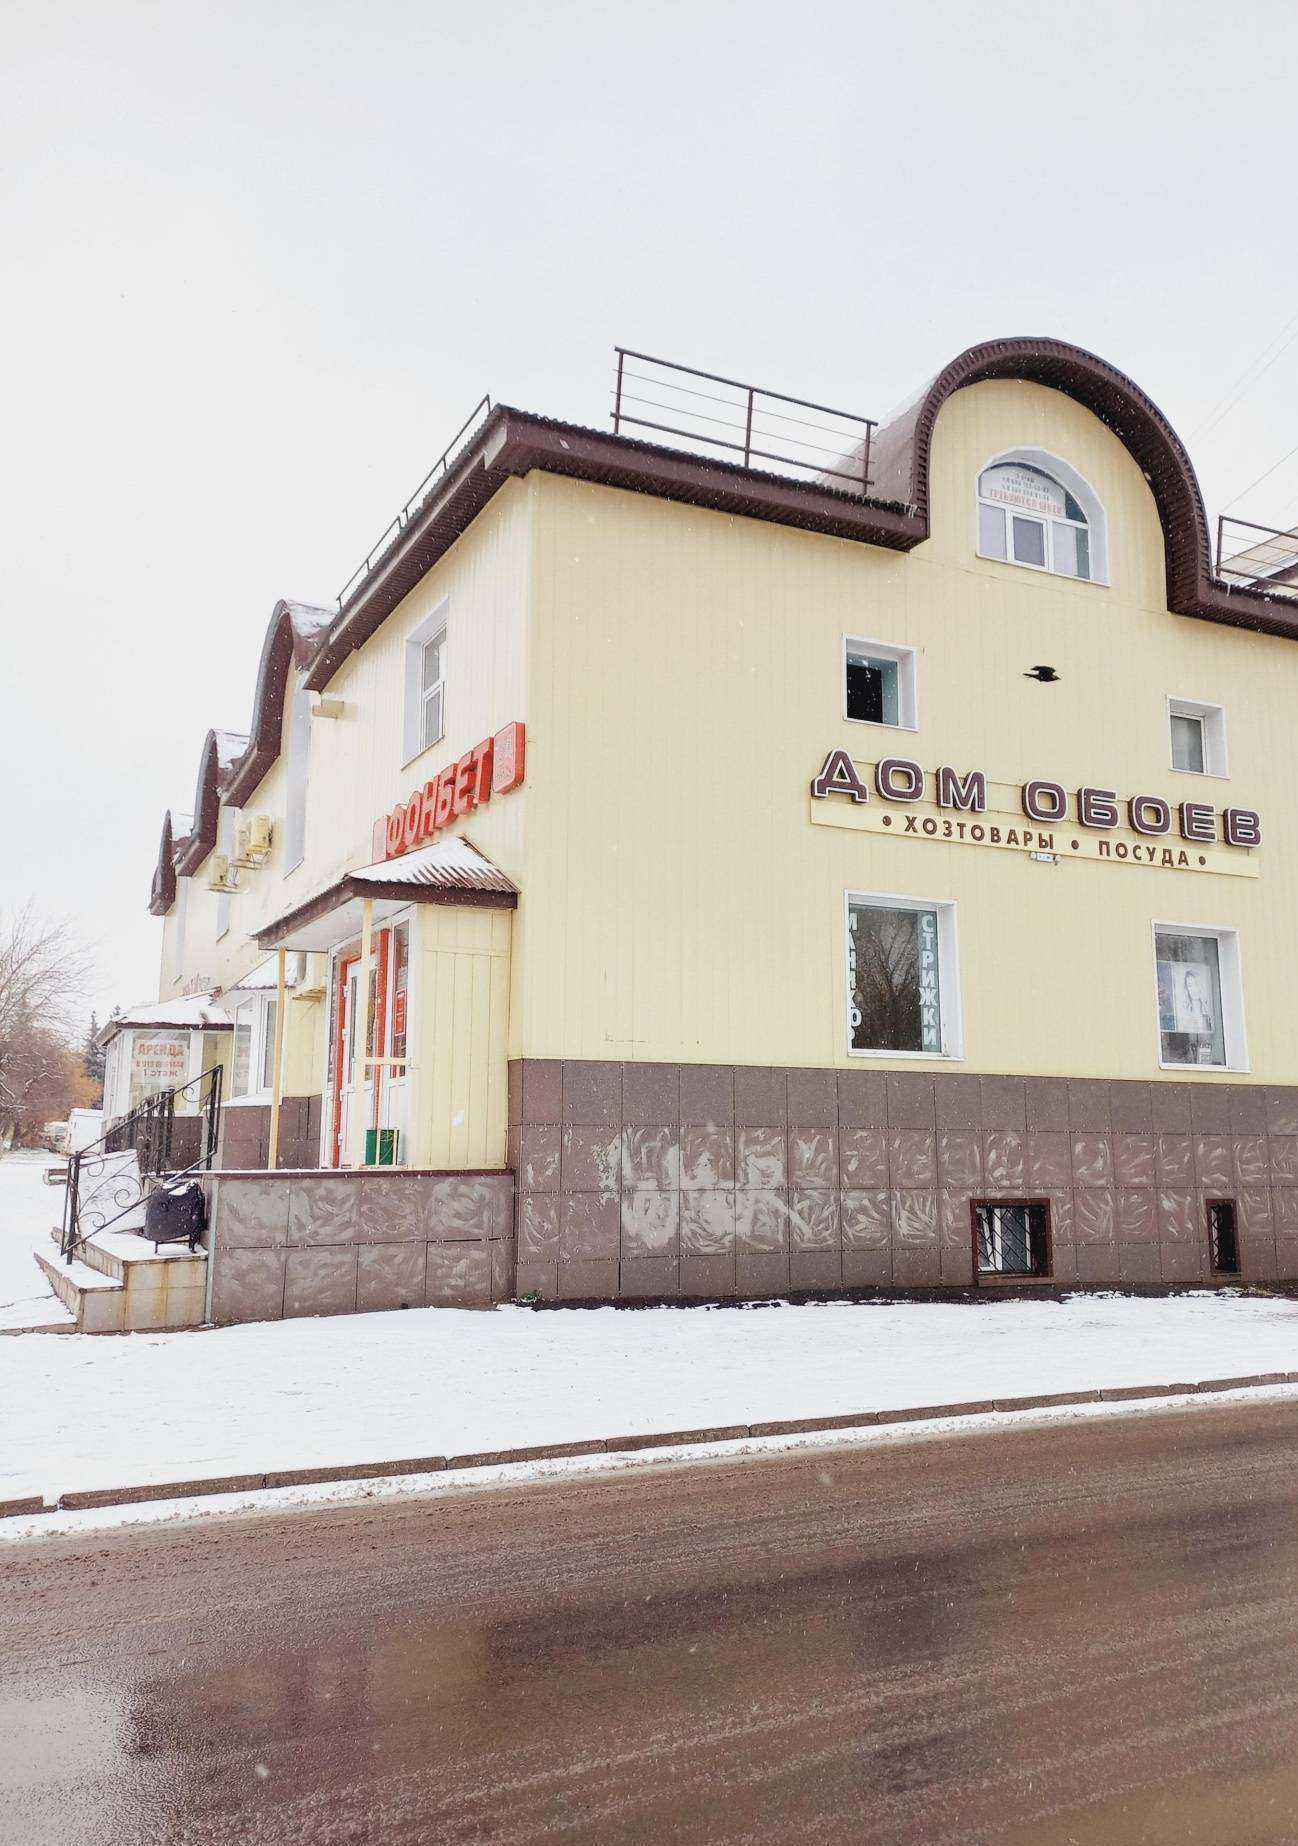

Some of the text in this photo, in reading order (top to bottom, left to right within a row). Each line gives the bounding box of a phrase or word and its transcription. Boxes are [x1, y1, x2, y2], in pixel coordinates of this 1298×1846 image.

[811, 748, 1262, 848] ДОМ ОБОЕВ
[904, 814, 1189, 867] ХОЗТОВАРЫ ПОСУДА
[919, 914, 938, 1046] СТРИЖКИ
